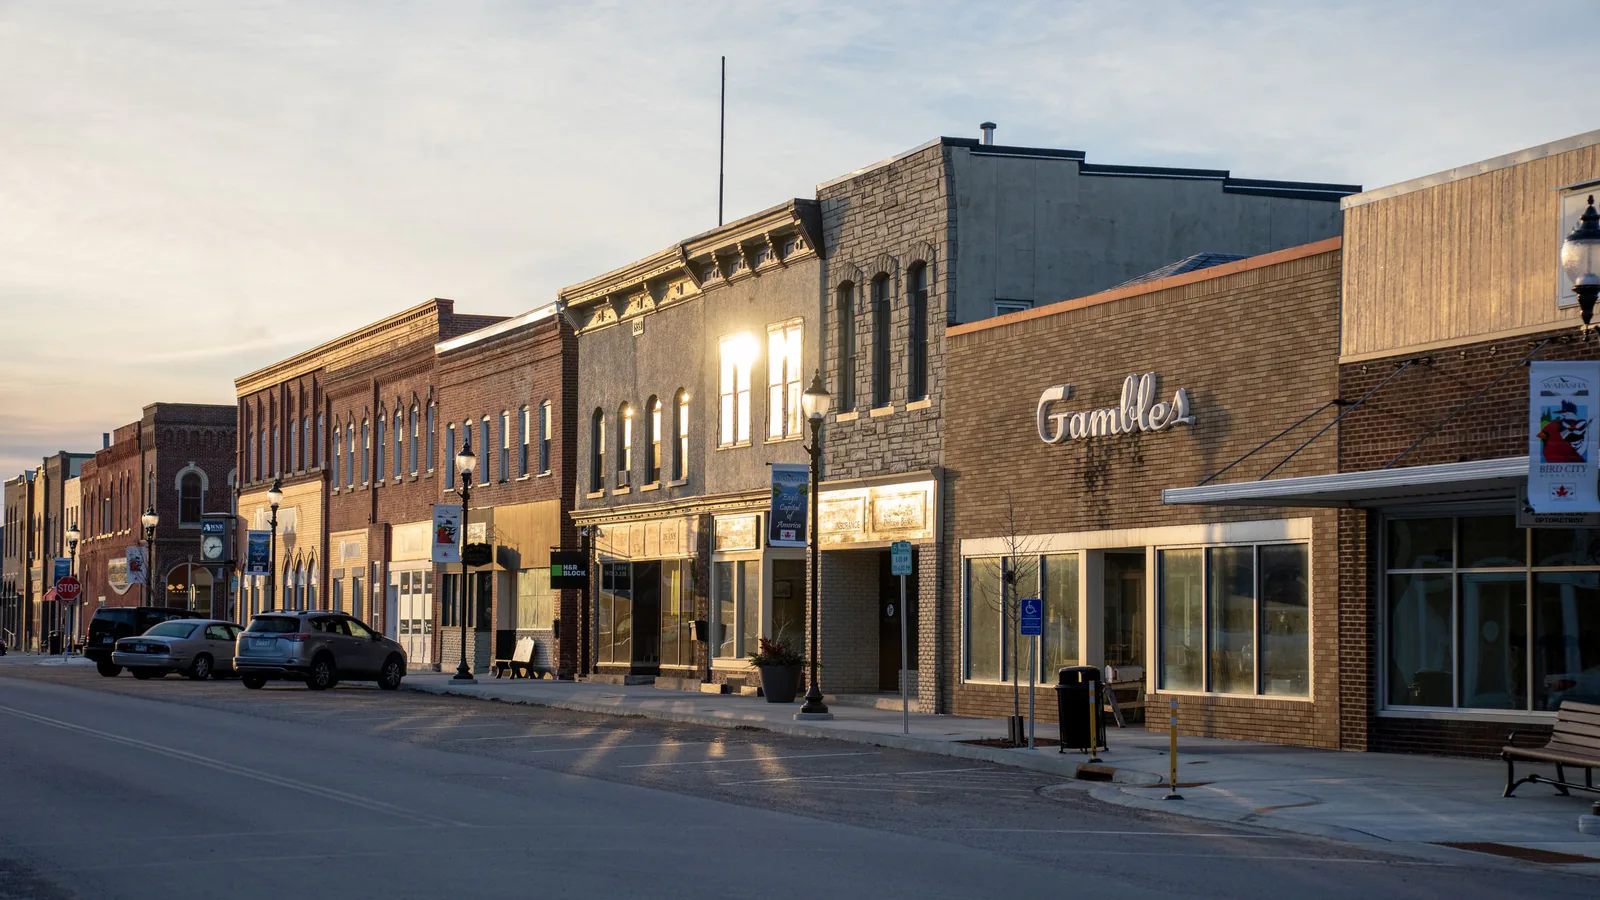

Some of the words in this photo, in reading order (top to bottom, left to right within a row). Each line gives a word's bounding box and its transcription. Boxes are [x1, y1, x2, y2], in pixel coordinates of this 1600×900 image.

[1036, 371, 1197, 445] Gambles
[1539, 464, 1563, 473] BIRD
[1564, 464, 1588, 473] CITY
[779, 502, 802, 514] Capital
[786, 511, 794, 521] of
[776, 520, 802, 529] America
[57, 583, 80, 593] STOP
